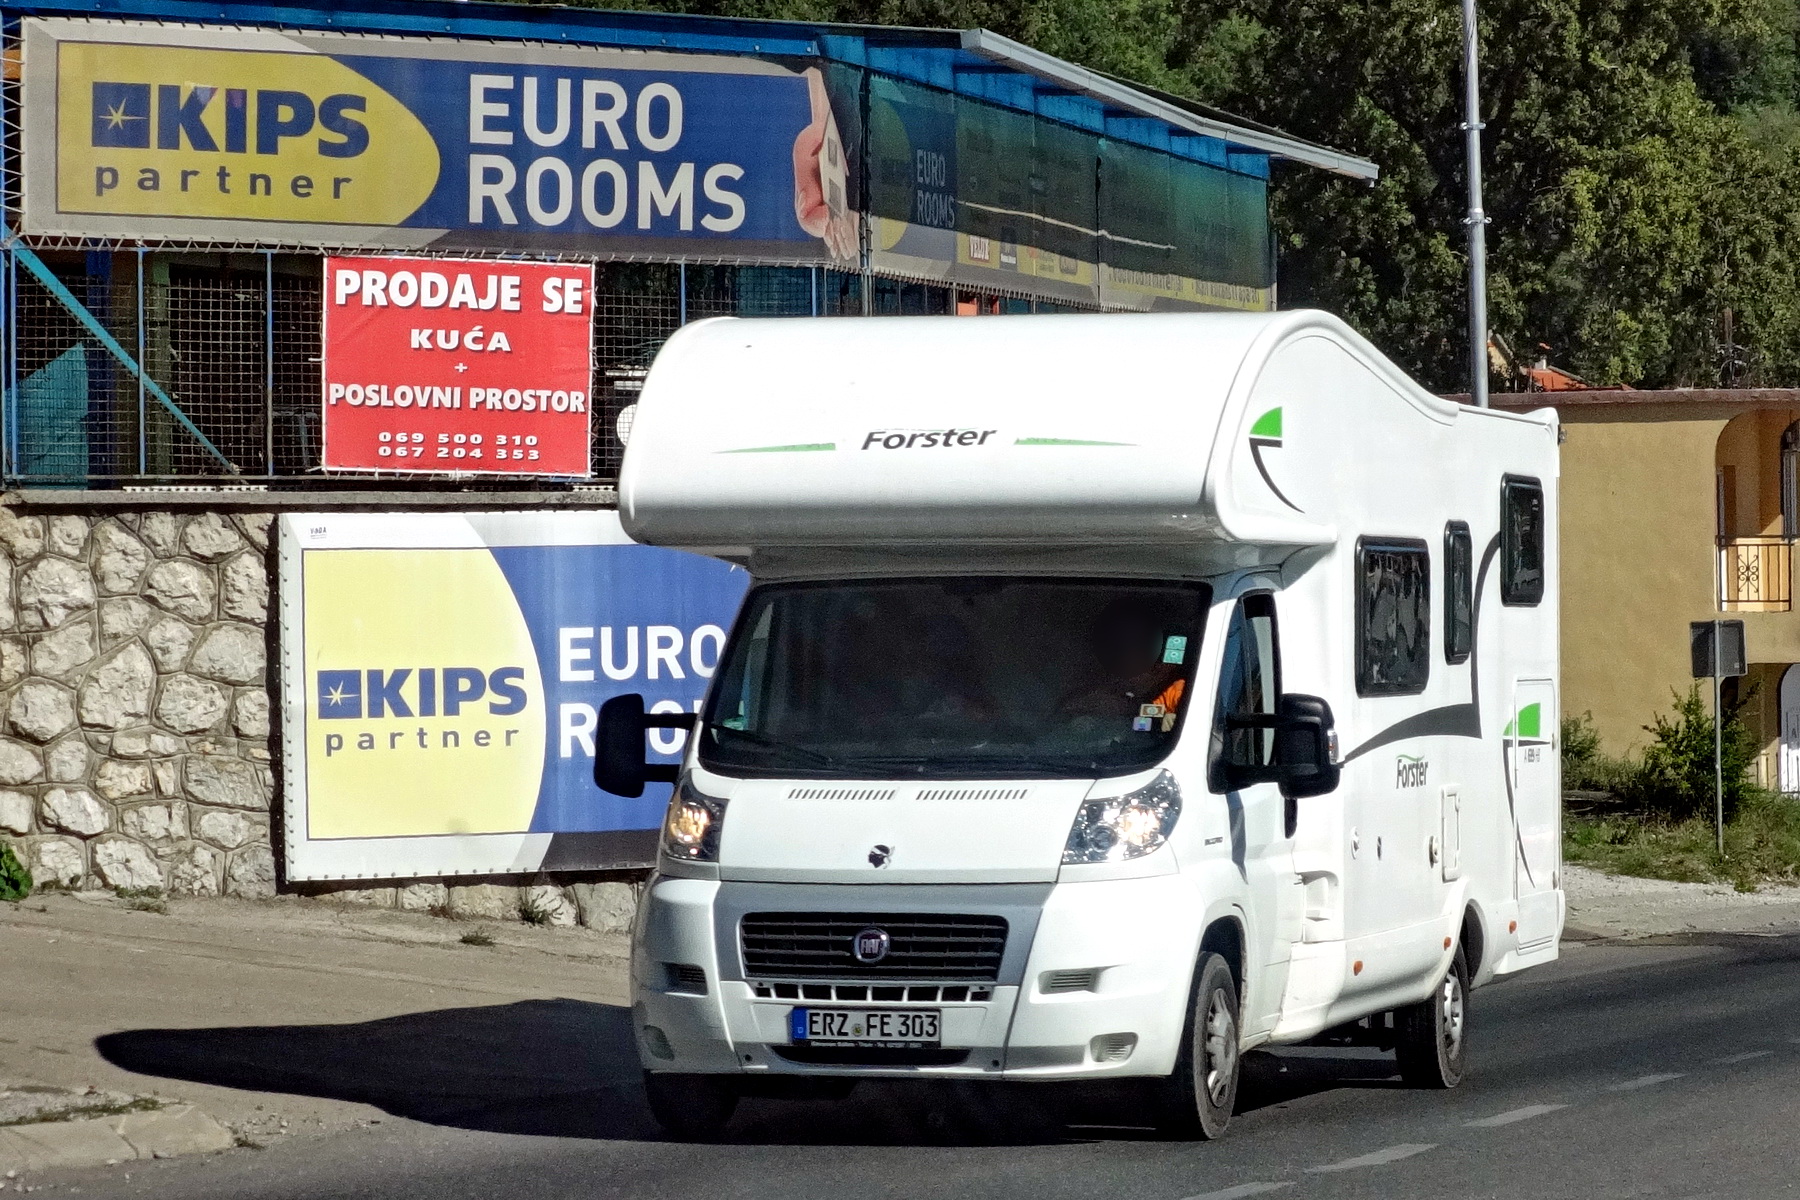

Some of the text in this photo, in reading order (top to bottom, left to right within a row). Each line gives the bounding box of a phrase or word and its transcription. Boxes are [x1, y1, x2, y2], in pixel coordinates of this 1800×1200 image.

[157, 84, 370, 158] KIPS
[469, 73, 683, 153] EURO
[95, 165, 353, 200] partner
[916, 149, 946, 187] EURO
[468, 153, 746, 233] ROOMS
[916, 189, 955, 228] ROOMS
[334, 269, 583, 314] PRODAJE SE
[410, 325, 512, 352] KUĆA
[454, 362, 468, 373] +
[329, 383, 585, 413] POSLOVNI PROSTOR
[378, 431, 538, 446] 069 500 310
[378, 446, 540, 460] 067 204 353
[860, 428, 998, 451] Forster
[559, 624, 727, 682] EURO
[366, 666, 528, 719] KIPS
[325, 726, 520, 757] partner
[1396, 757, 1429, 789] Forster
[808, 1012, 938, 1038] ERZ FE 303
